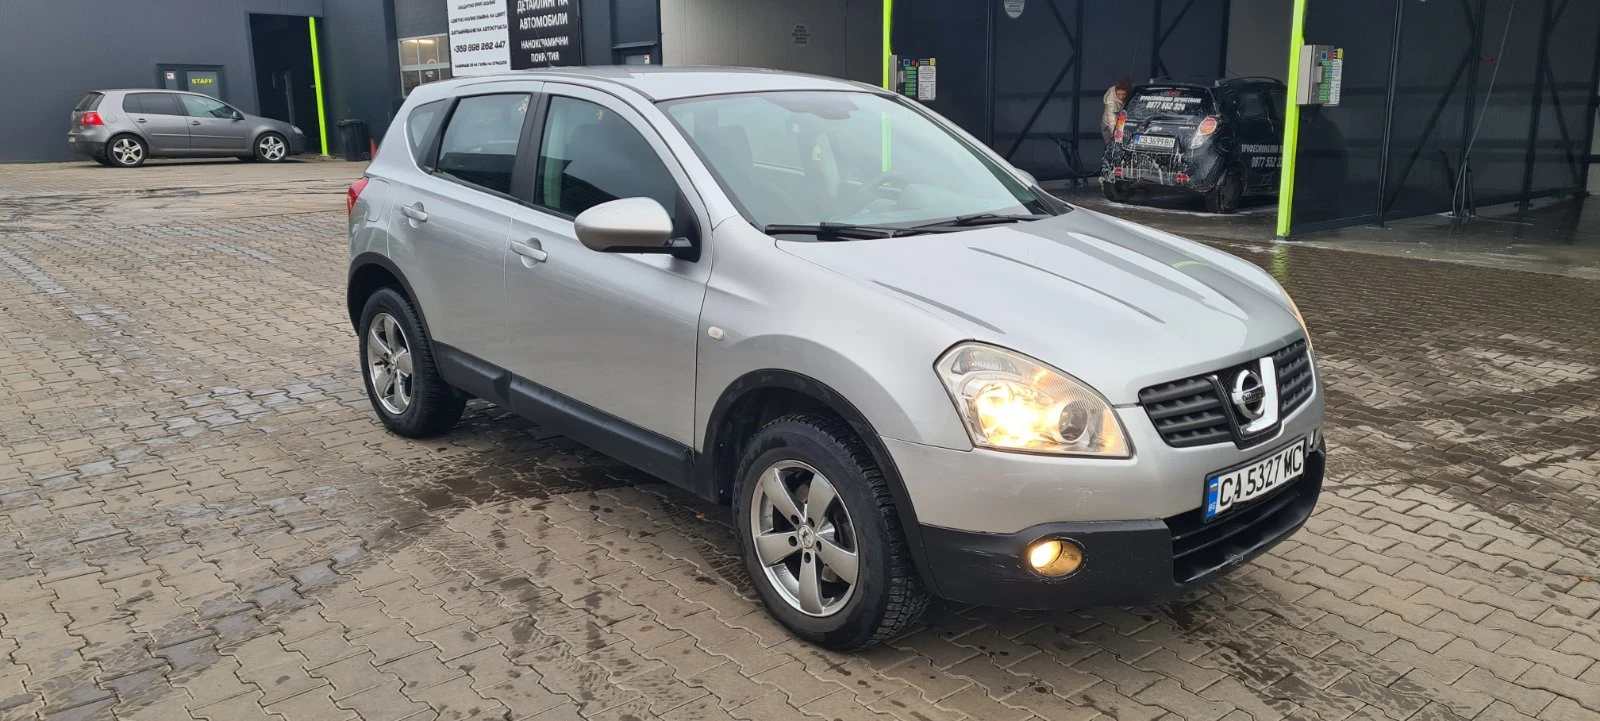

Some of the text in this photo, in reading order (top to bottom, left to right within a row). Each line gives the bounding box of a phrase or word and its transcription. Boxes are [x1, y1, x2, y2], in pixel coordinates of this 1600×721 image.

[520, 12, 568, 30] АВТОМОБИЛИ
[1219, 446, 1302, 507] CA 5327 MC
